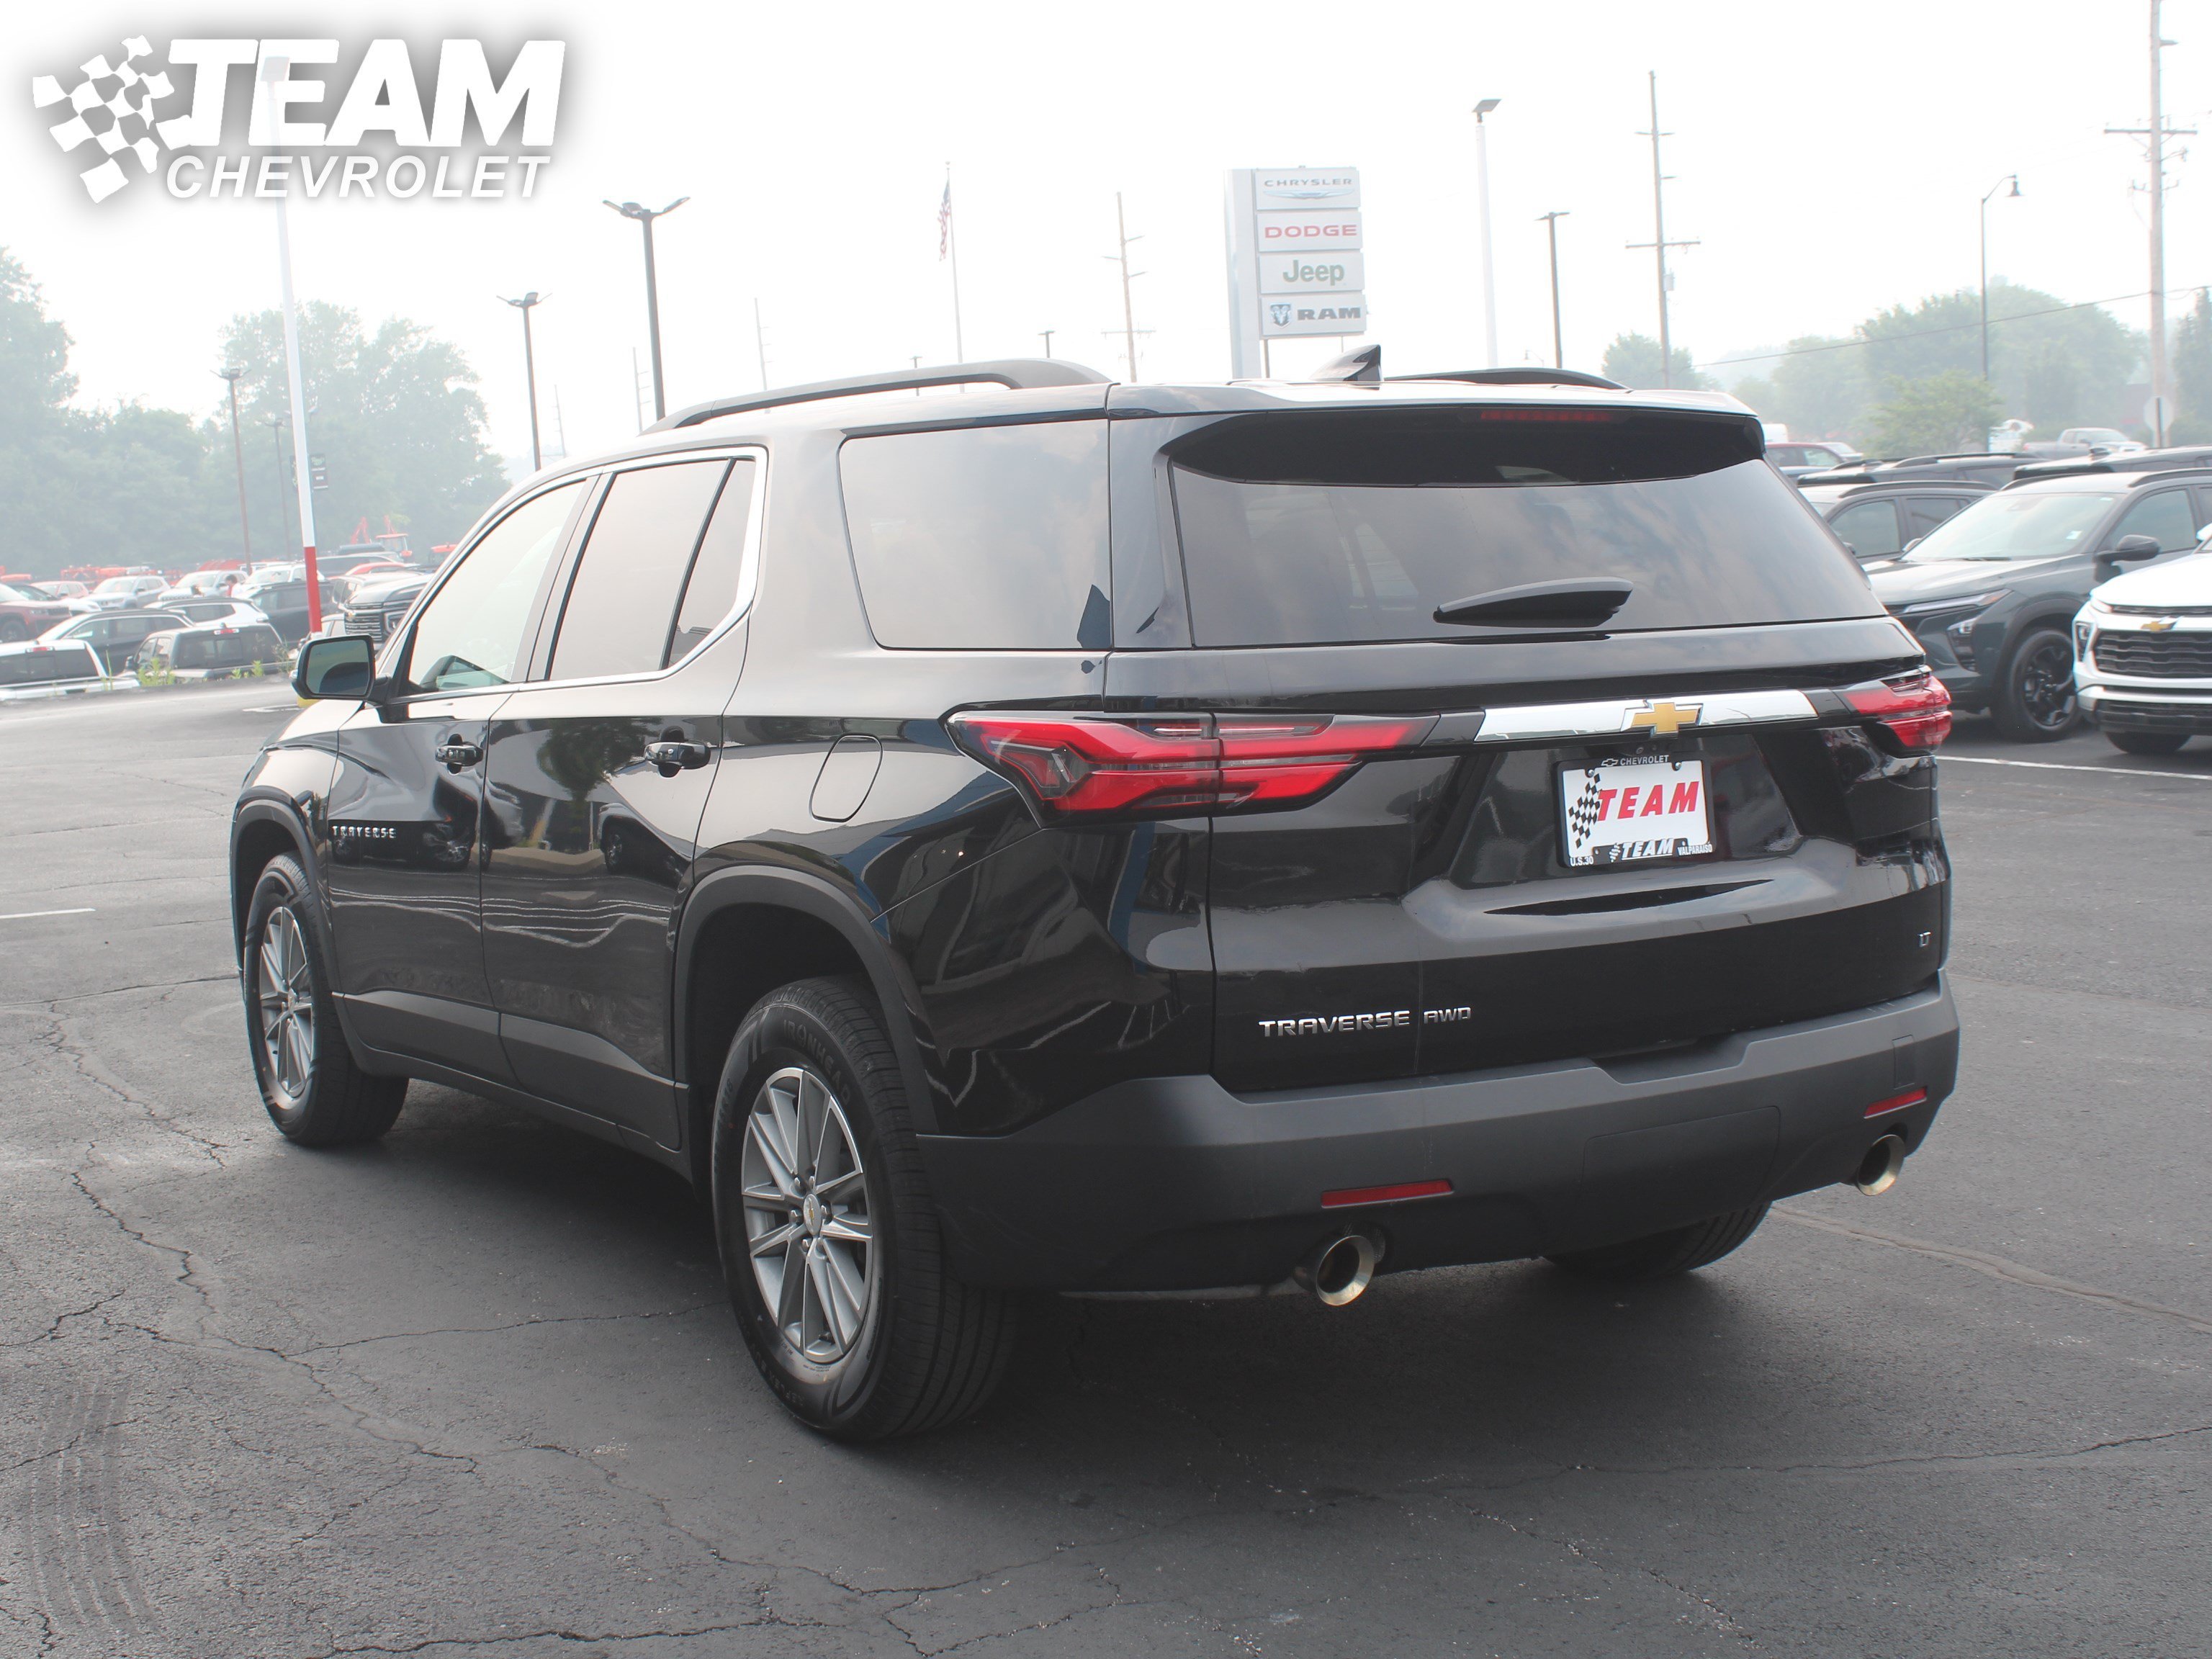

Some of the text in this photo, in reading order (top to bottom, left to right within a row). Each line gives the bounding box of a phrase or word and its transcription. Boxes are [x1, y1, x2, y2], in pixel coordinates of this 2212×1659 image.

[1264, 179, 1352, 187] CHRYSLER
[1264, 225, 1357, 238] DODGE
[1282, 259, 1345, 286] Jeep
[1298, 307, 1361, 320] RAM
[1620, 755, 1669, 766] CHEVROLET
[1597, 781, 1699, 822] TEAM
[332, 825, 396, 838] TRAVERSE
[1622, 838, 1675, 860] TEAM
[1677, 843, 1713, 856] VALPARAISO
[1259, 1007, 1471, 1037] TRAVERSE AWD
[783, 1019, 851, 1106] IRONHEAD
